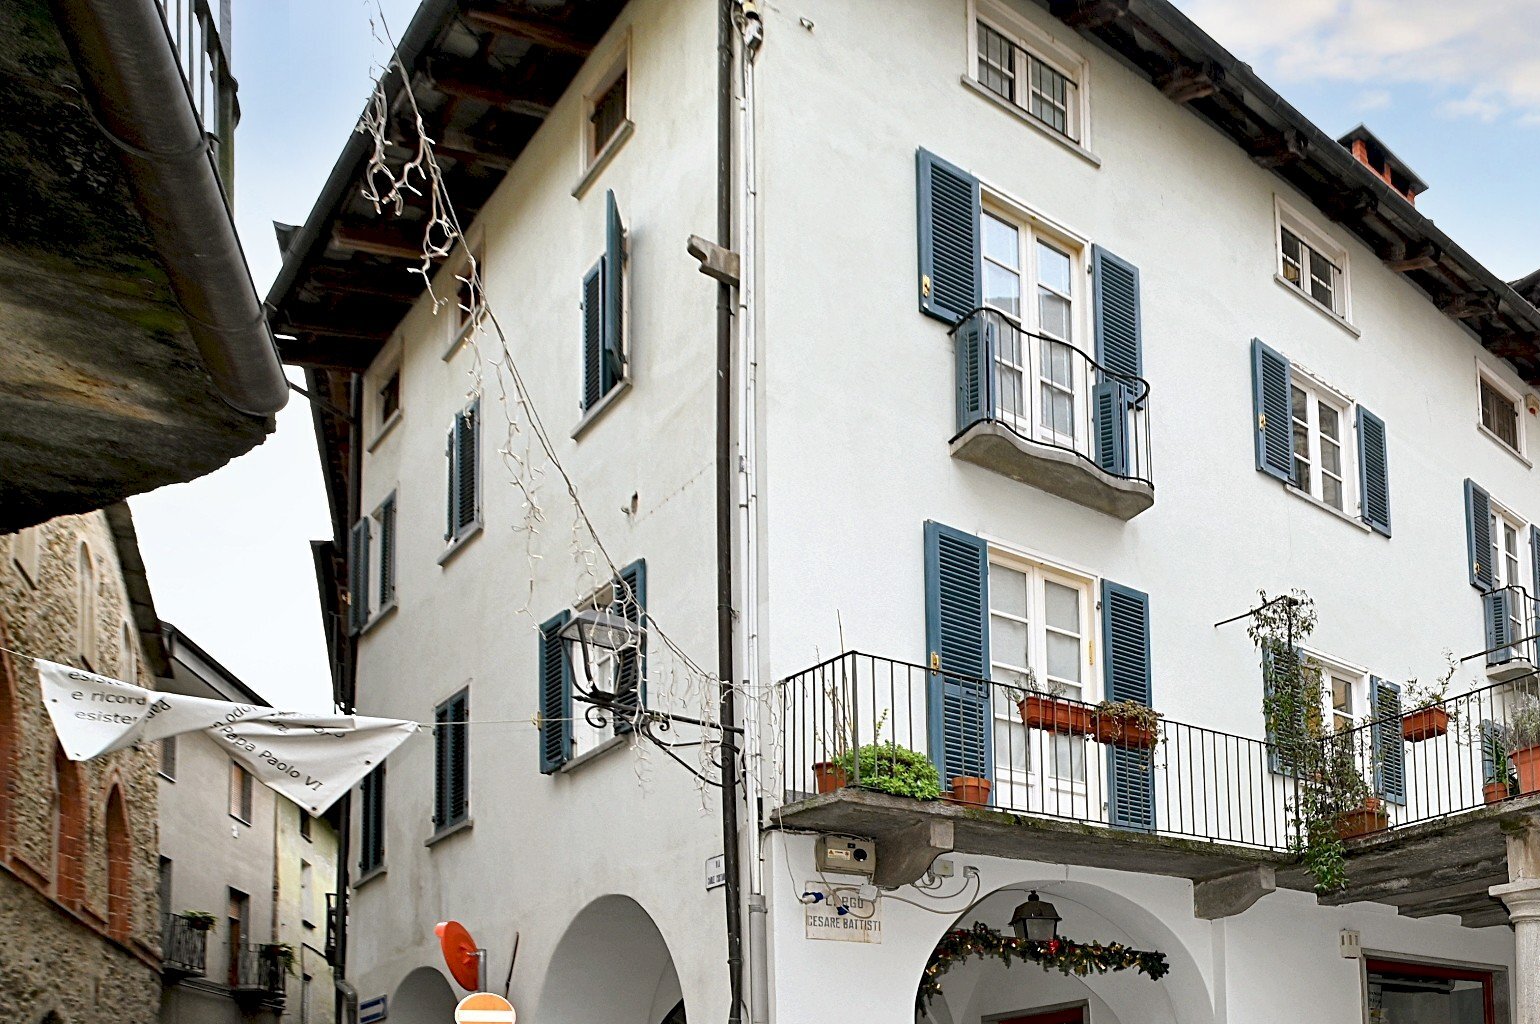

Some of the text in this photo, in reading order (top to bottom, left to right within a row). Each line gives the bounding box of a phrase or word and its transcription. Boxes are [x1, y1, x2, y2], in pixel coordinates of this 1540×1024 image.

[71, 691, 84, 701] e
[219, 725, 256, 752] Papa
[258, 749, 301, 779] Paolo
[305, 776, 324, 792] VI
[826, 896, 865, 909] LRGO
[808, 915, 881, 932] CESARE BATTISTI
